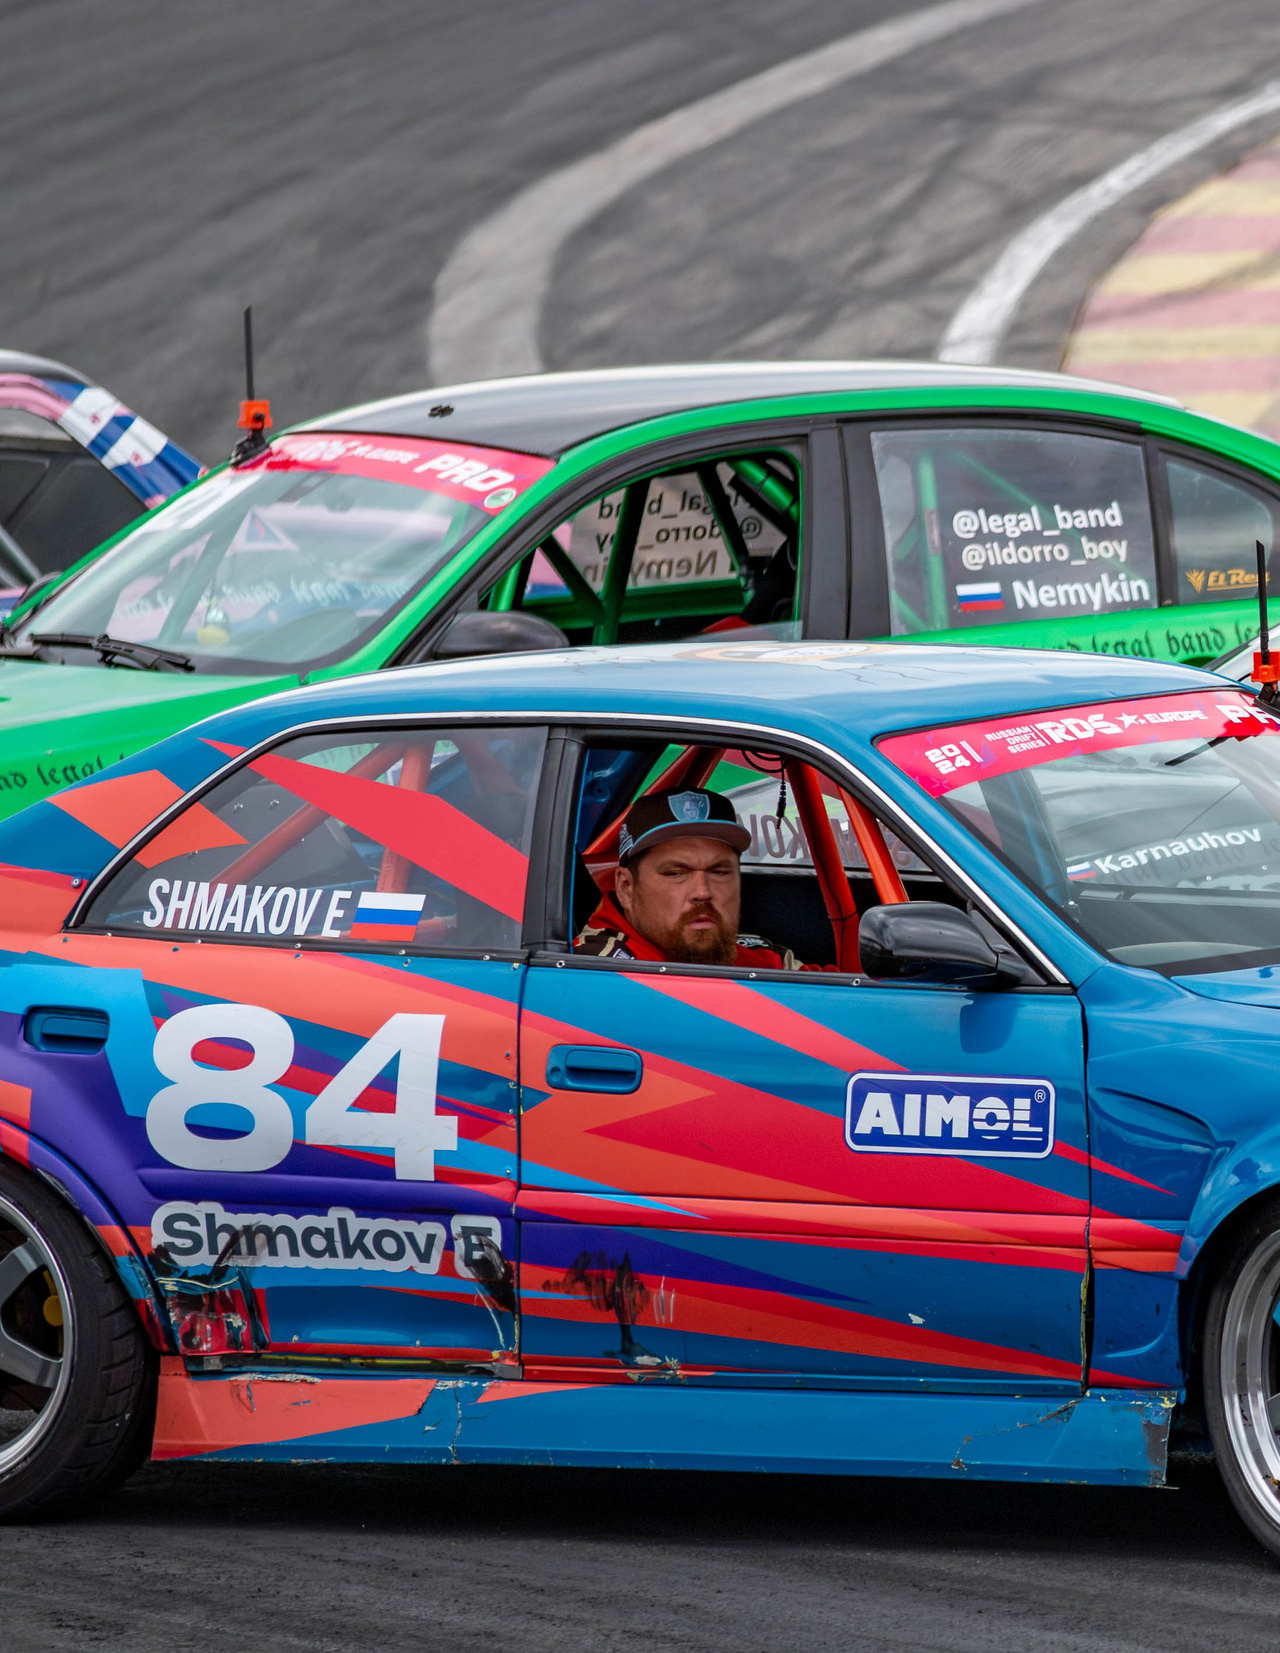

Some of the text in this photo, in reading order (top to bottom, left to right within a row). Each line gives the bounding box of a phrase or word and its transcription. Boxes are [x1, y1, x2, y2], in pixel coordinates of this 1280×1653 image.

[413, 453, 515, 491] PRO
[952, 501, 1123, 538] @legal_band
[962, 536, 1128, 570] @ildorro_boy
[1013, 573, 1151, 611] Nemykin
[1227, 568, 1270, 586] Re
[984, 726, 1033, 742] RUSSIAN
[1006, 733, 1038, 746] DRIFT
[1035, 713, 1123, 744] RDS
[1147, 709, 1208, 724] EUROPE
[1007, 740, 1046, 754] SERIES
[1094, 828, 1262, 875] Karnauhov
[143, 879, 352, 938] SHMAKOV E
[146, 1003, 459, 1181] 84
[854, 1092, 1044, 1141] AIMOL
[162, 1212, 438, 1265] Shmakov
